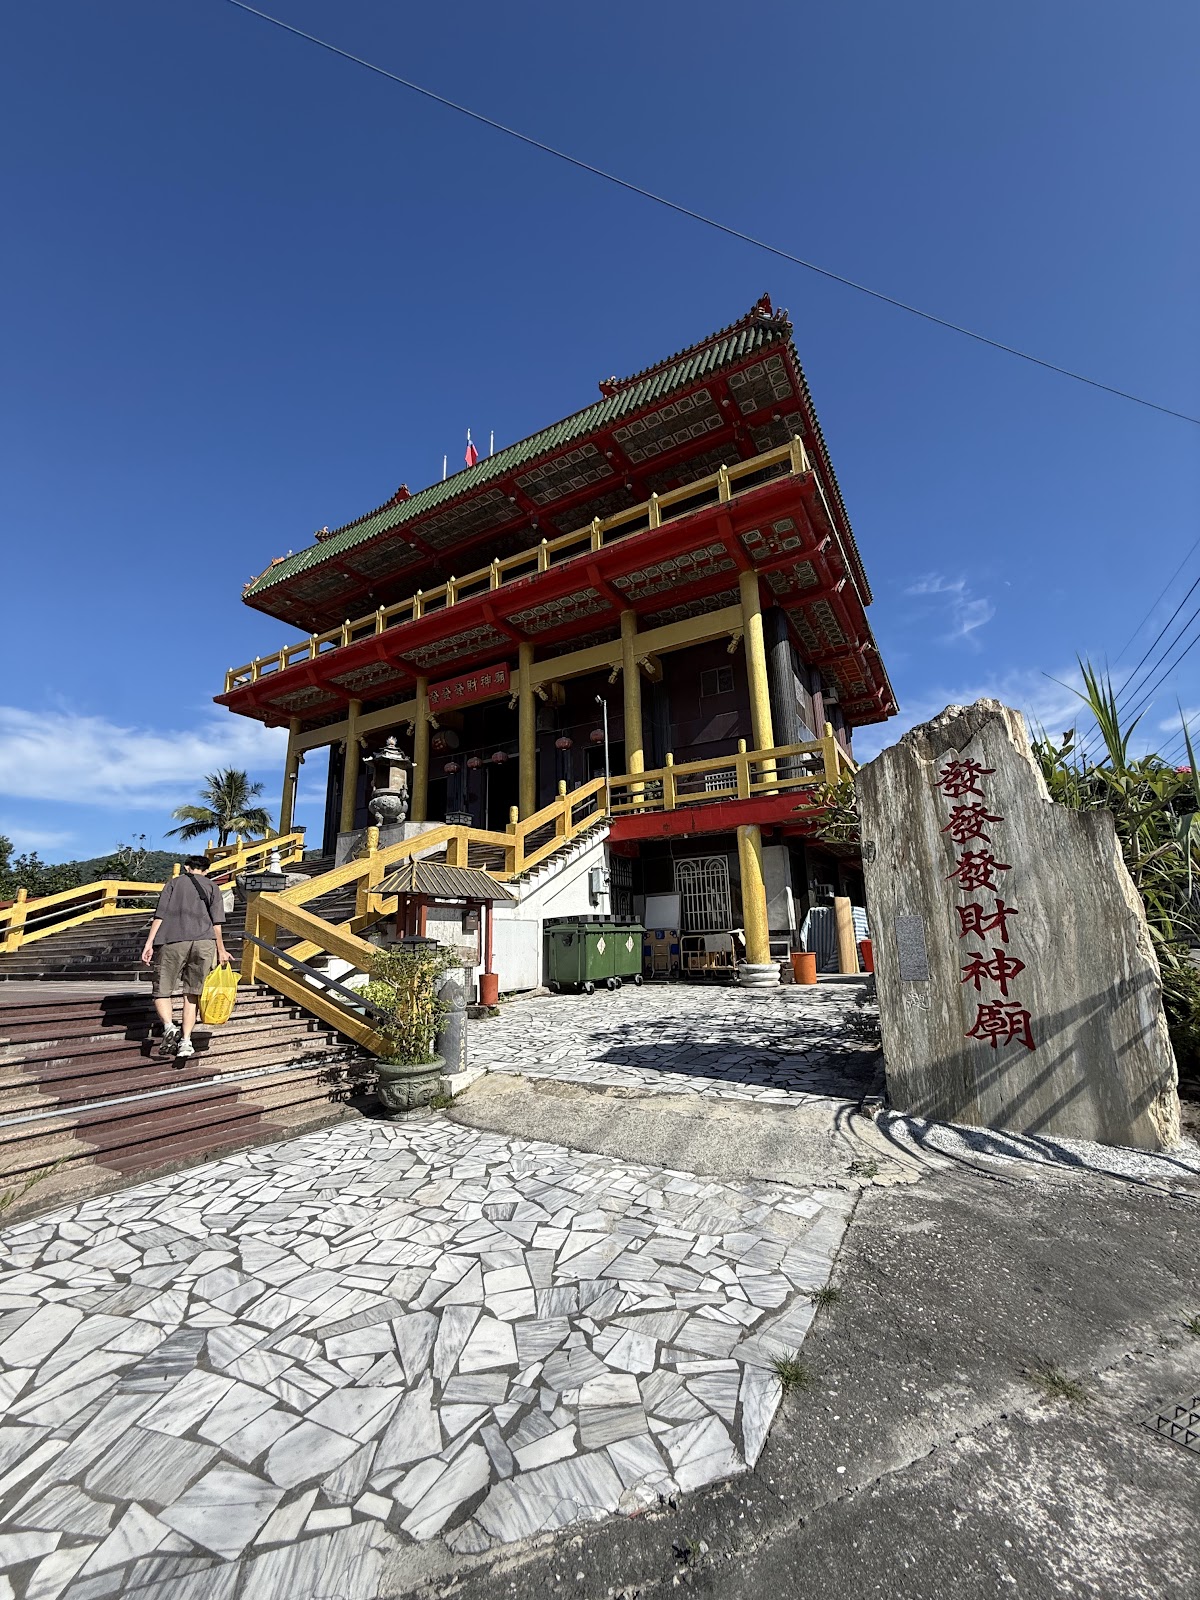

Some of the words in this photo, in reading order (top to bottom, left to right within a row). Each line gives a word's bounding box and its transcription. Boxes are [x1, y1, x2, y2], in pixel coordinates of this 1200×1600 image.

[429, 670, 506, 704] 發發發財神廟
[933, 757, 1036, 1051] 發發發財神廟
